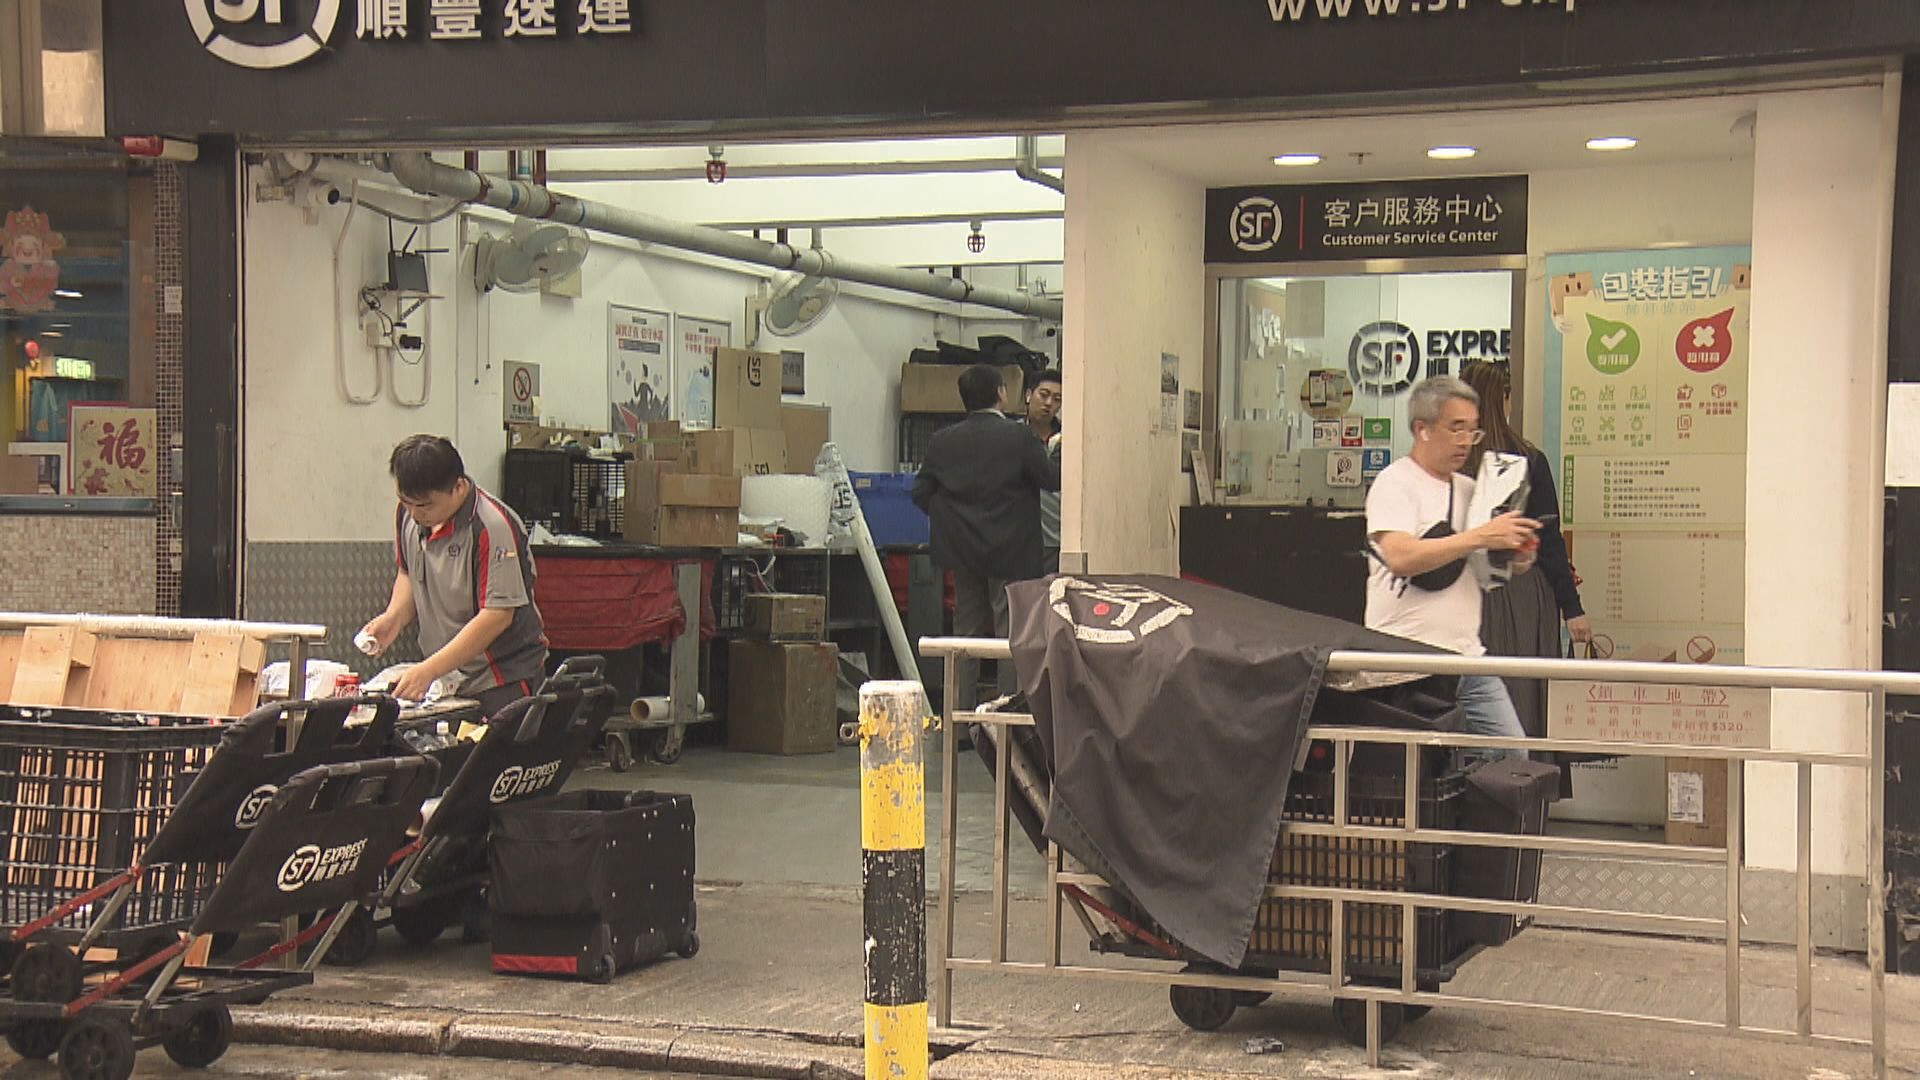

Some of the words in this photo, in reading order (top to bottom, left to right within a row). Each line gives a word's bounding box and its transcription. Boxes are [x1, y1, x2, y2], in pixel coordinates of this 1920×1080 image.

[1322, 233, 1391, 246] Customer
[1394, 231, 1446, 244] Service
[1449, 229, 1498, 242] Center
[1601, 265, 1722, 302] 包裝指引
[97, 417, 146, 470] 福
[523, 759, 562, 782] EXPRESS
[321, 838, 369, 864] EXPRESS
